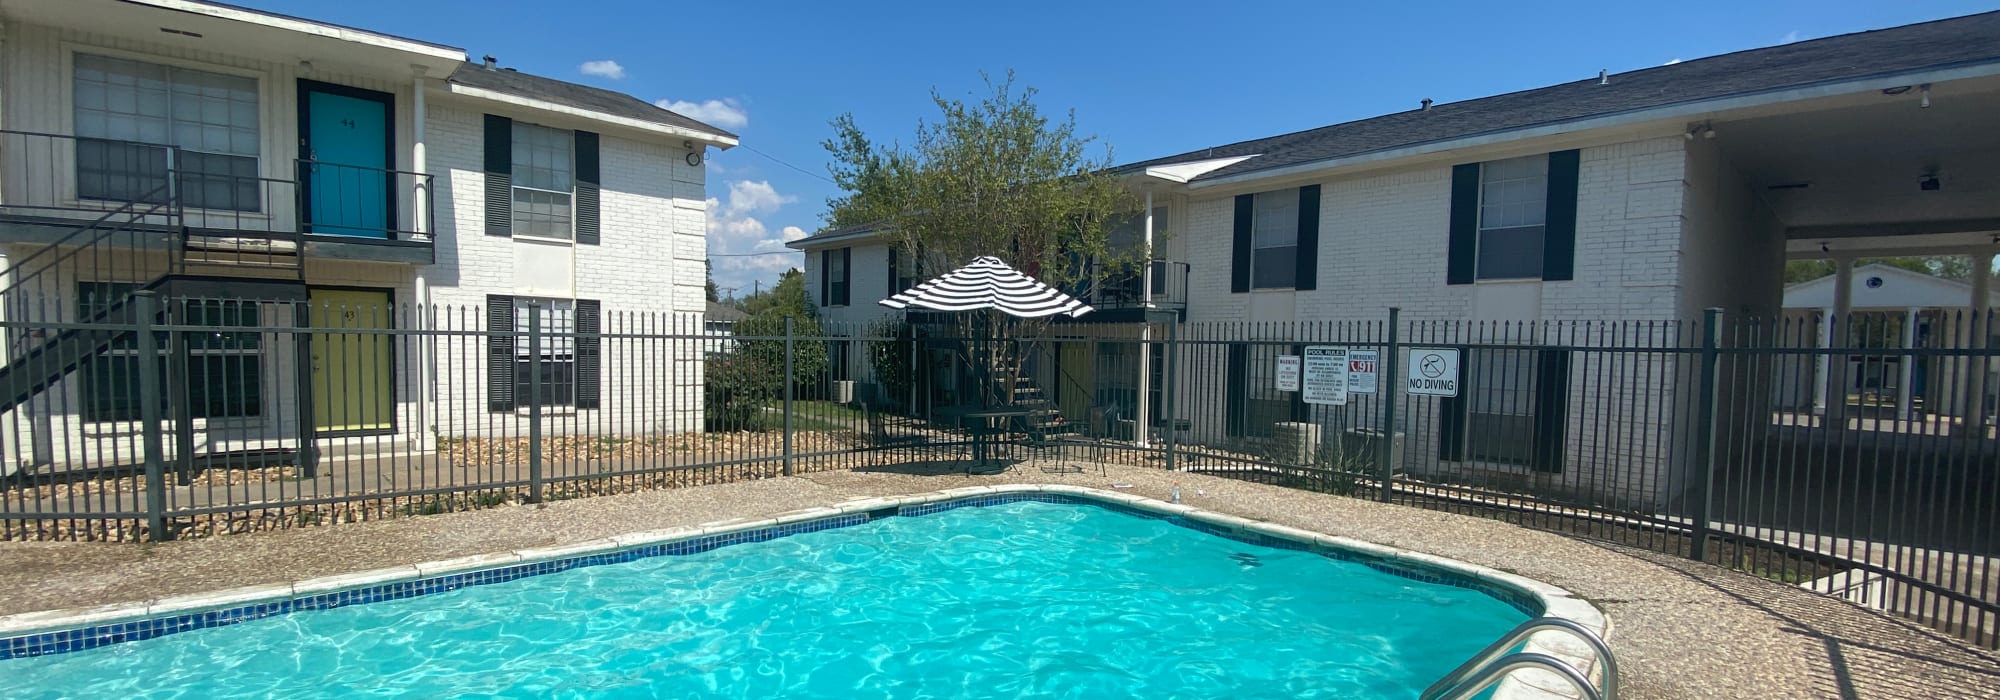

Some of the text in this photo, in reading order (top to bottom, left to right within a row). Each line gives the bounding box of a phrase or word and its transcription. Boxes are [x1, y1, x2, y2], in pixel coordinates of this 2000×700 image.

[1359, 361, 1376, 372] 911
[1410, 379, 1454, 391] NO DIVING
